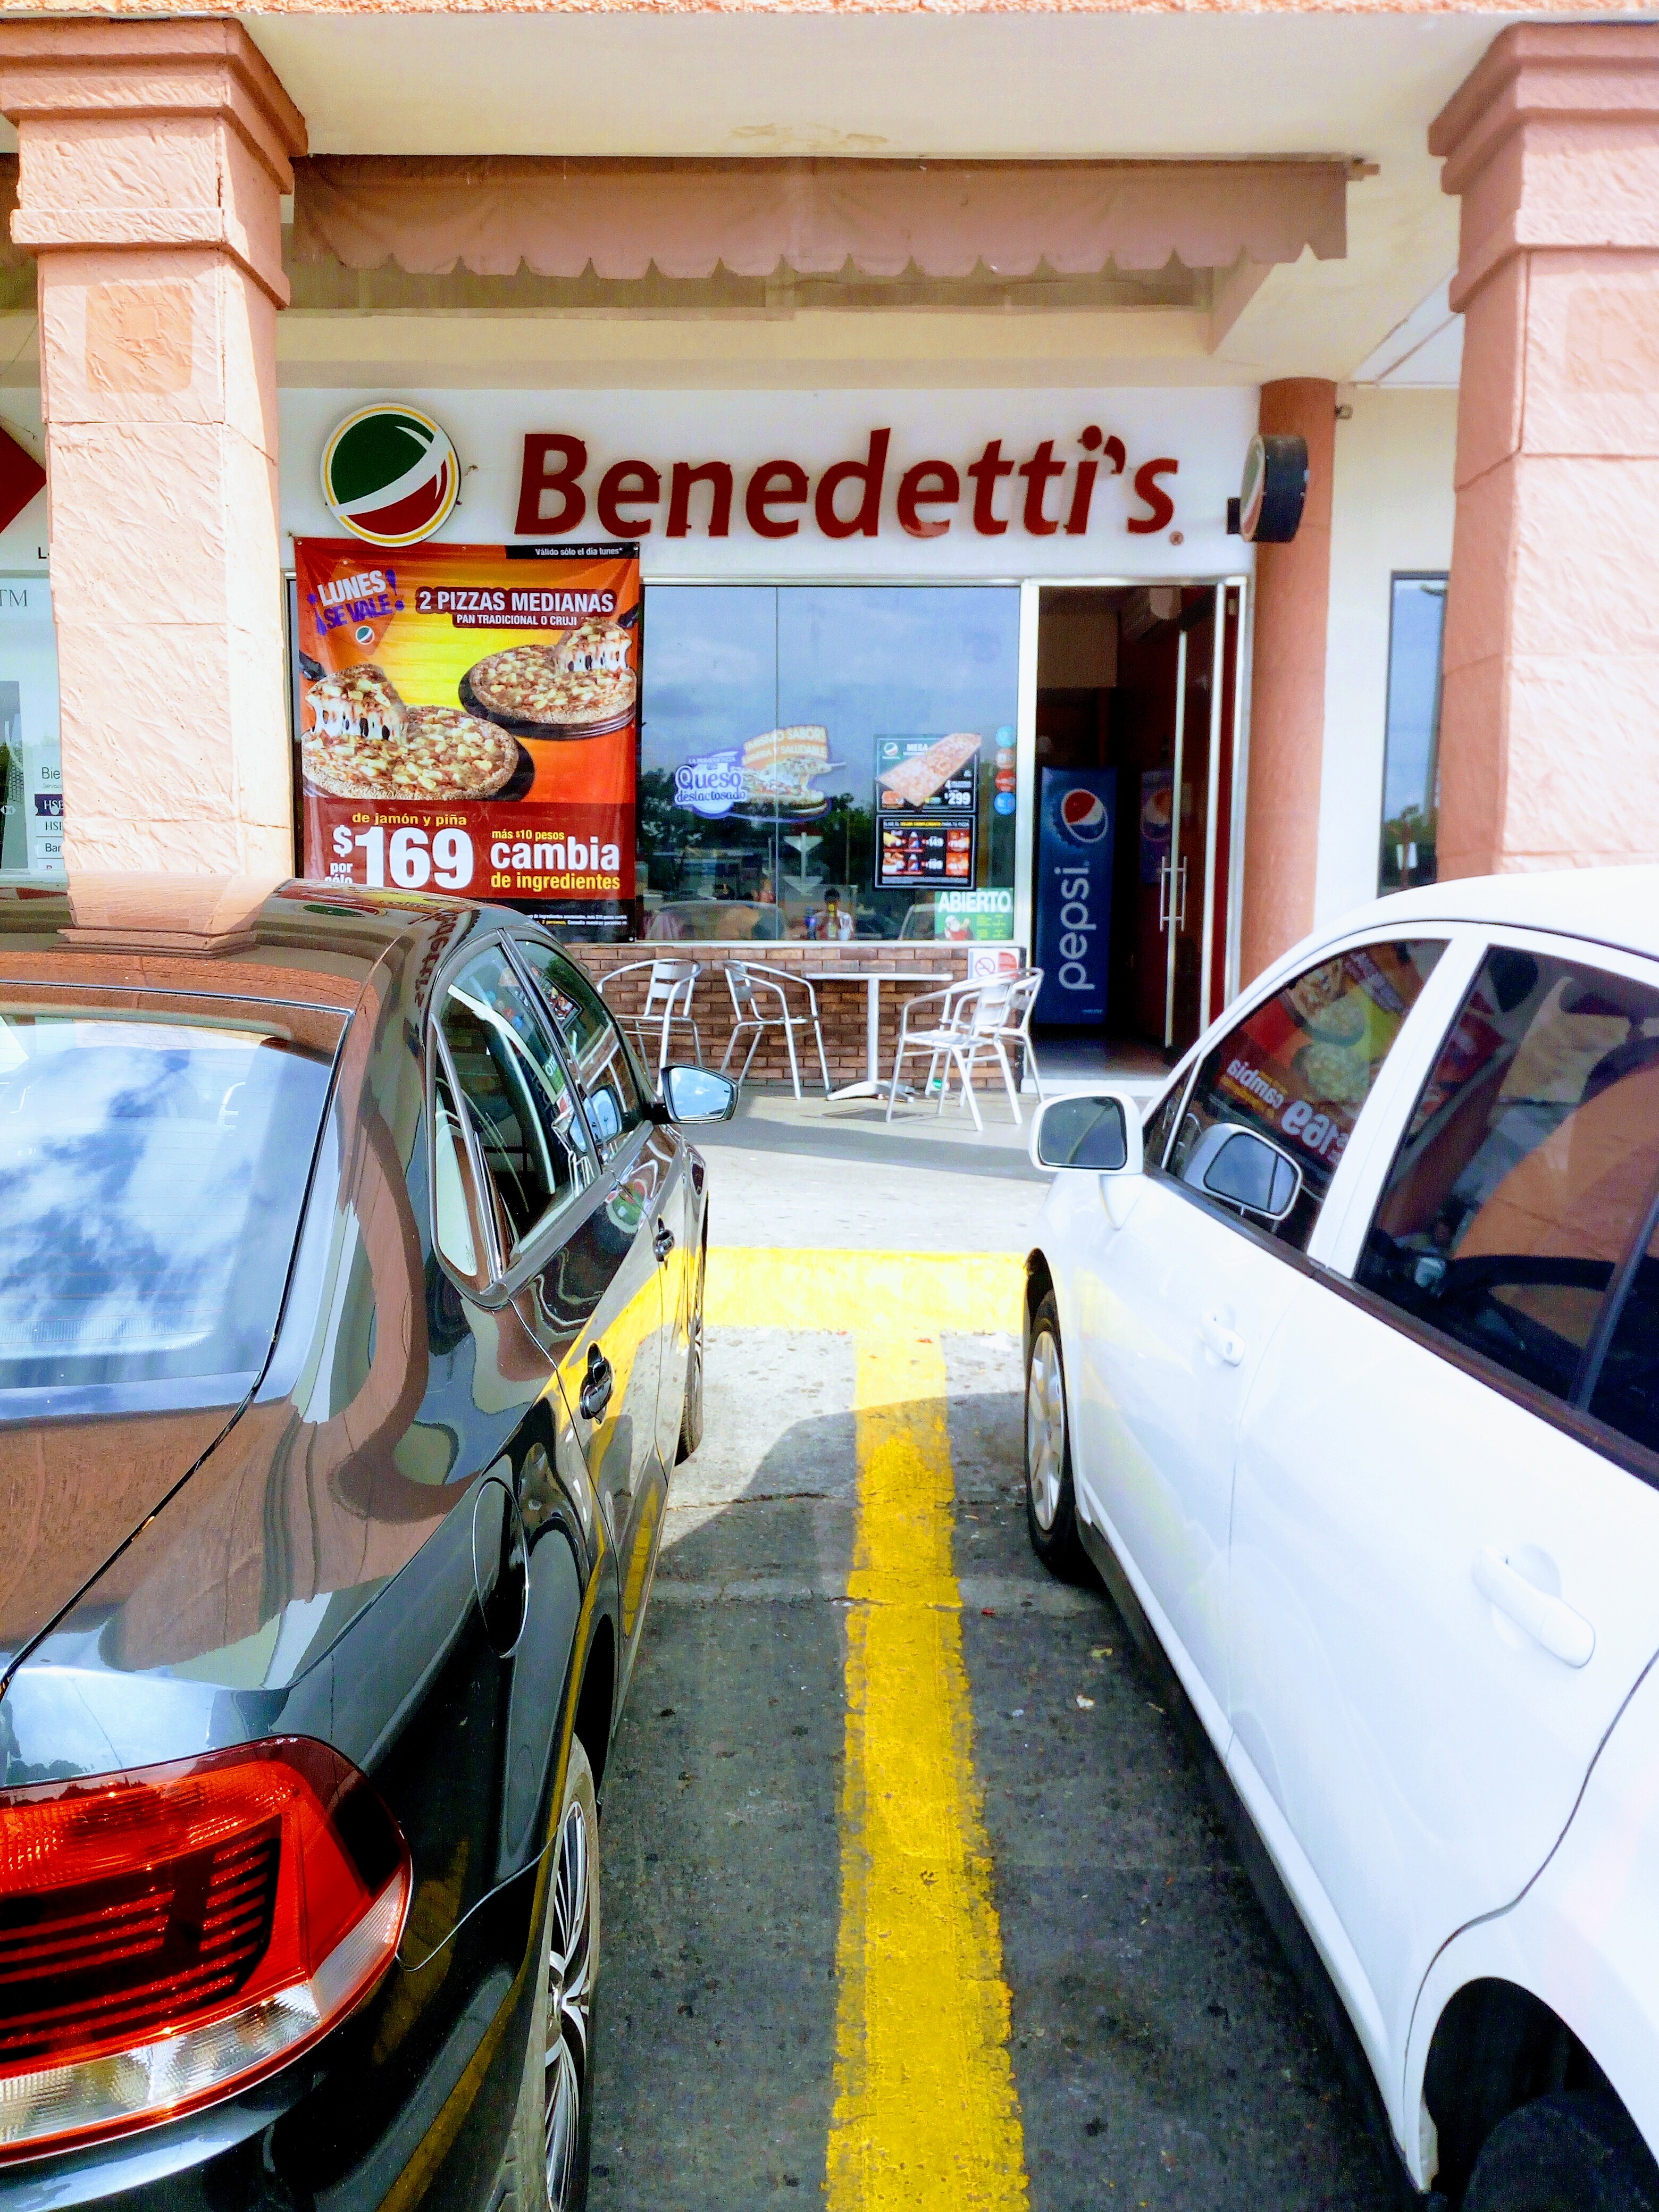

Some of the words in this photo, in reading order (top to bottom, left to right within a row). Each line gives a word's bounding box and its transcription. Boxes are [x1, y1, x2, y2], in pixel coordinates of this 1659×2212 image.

[513, 424, 1180, 538] Benedetti's
[420, 591, 431, 609] 2
[438, 591, 505, 610] PIZZAS
[512, 592, 614, 613] MEDIANAS
[456, 614, 475, 624] PAN
[477, 614, 539, 625] TRADICIONAL
[541, 615, 547, 625] O
[677, 767, 743, 790] Queso
[676, 789, 746, 803] deslactosado
[352, 812, 370, 823] de
[375, 812, 418, 825] jamón
[423, 816, 431, 827] y
[435, 814, 467, 827] piña
[492, 828, 513, 840] más
[535, 831, 565, 841] pesos
[490, 835, 620, 870] cambia
[330, 861, 353, 875] por
[490, 872, 512, 888] de
[516, 872, 621, 893] ingredientes
[938, 891, 1011, 913] ABIERTO
[1054, 866, 1097, 991] pepsi
